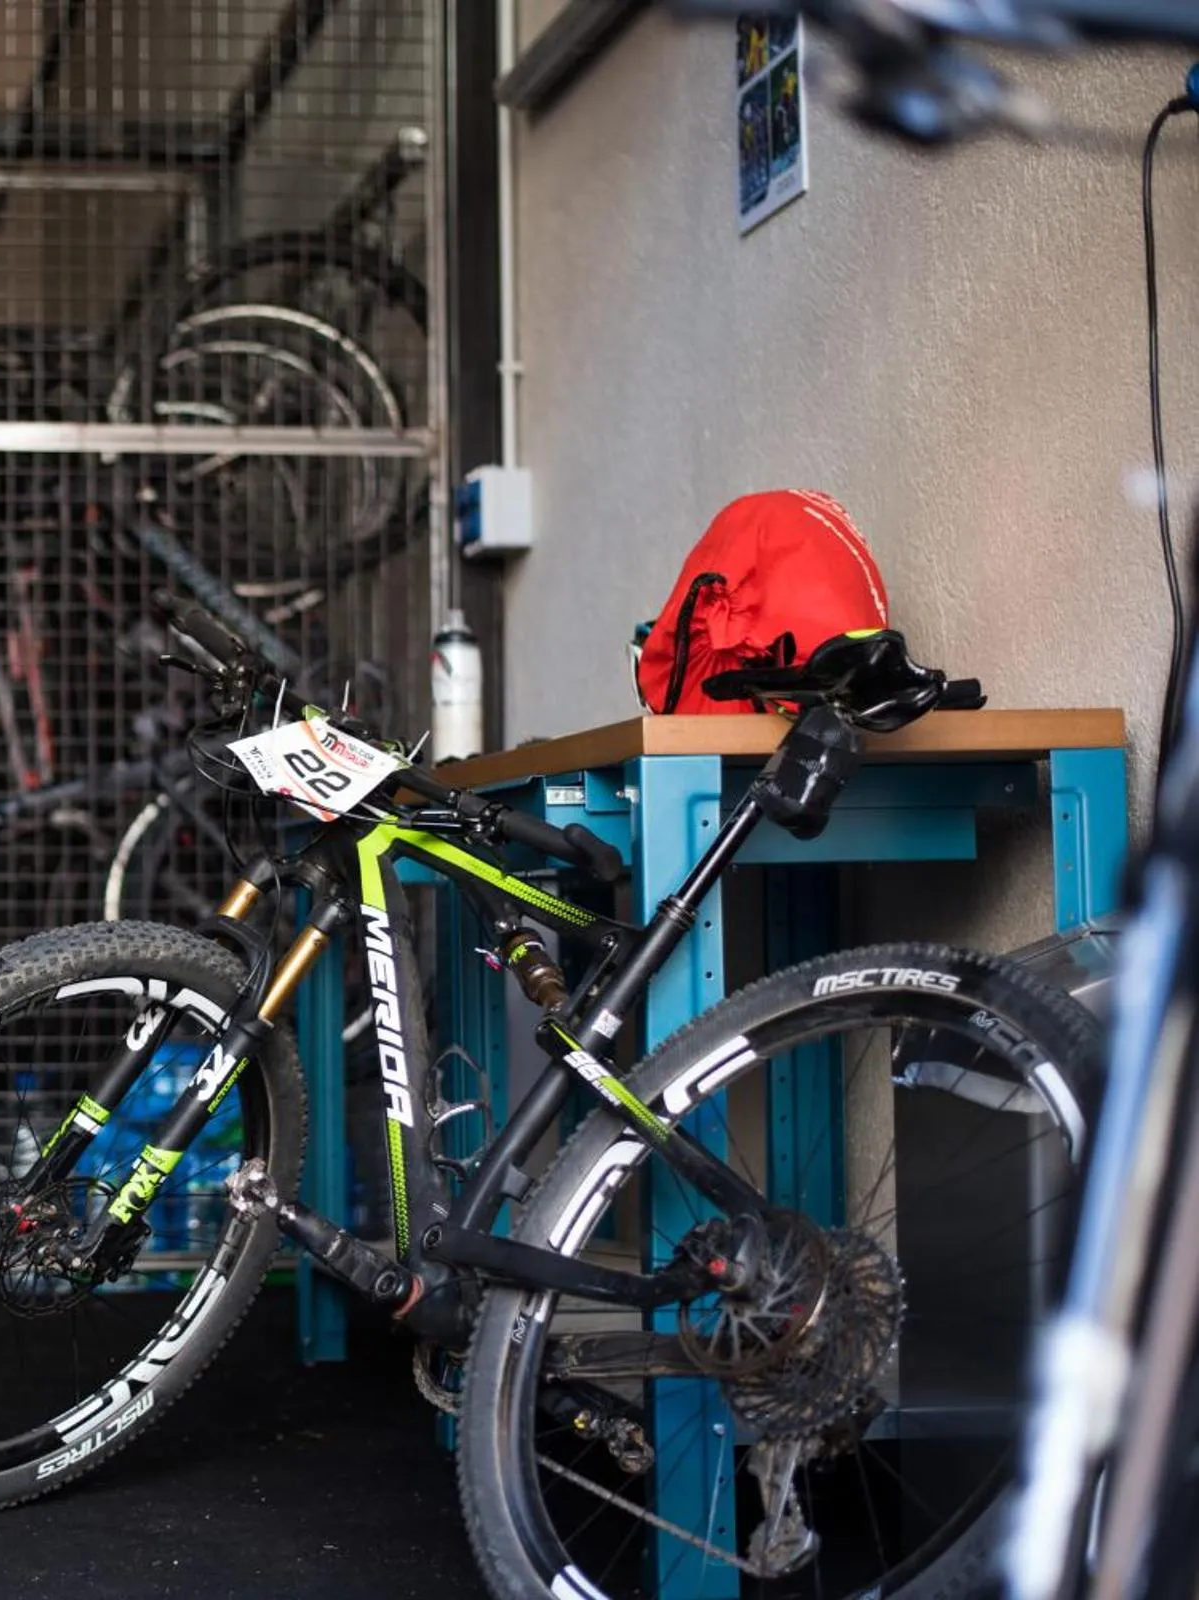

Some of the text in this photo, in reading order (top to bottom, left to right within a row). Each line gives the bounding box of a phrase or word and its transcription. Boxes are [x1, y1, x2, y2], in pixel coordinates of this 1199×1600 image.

[284, 749, 351, 799] 22
[360, 904, 414, 1127] MERIDA
[189, 1043, 236, 1100] 32
[107, 1162, 160, 1224] FOX
